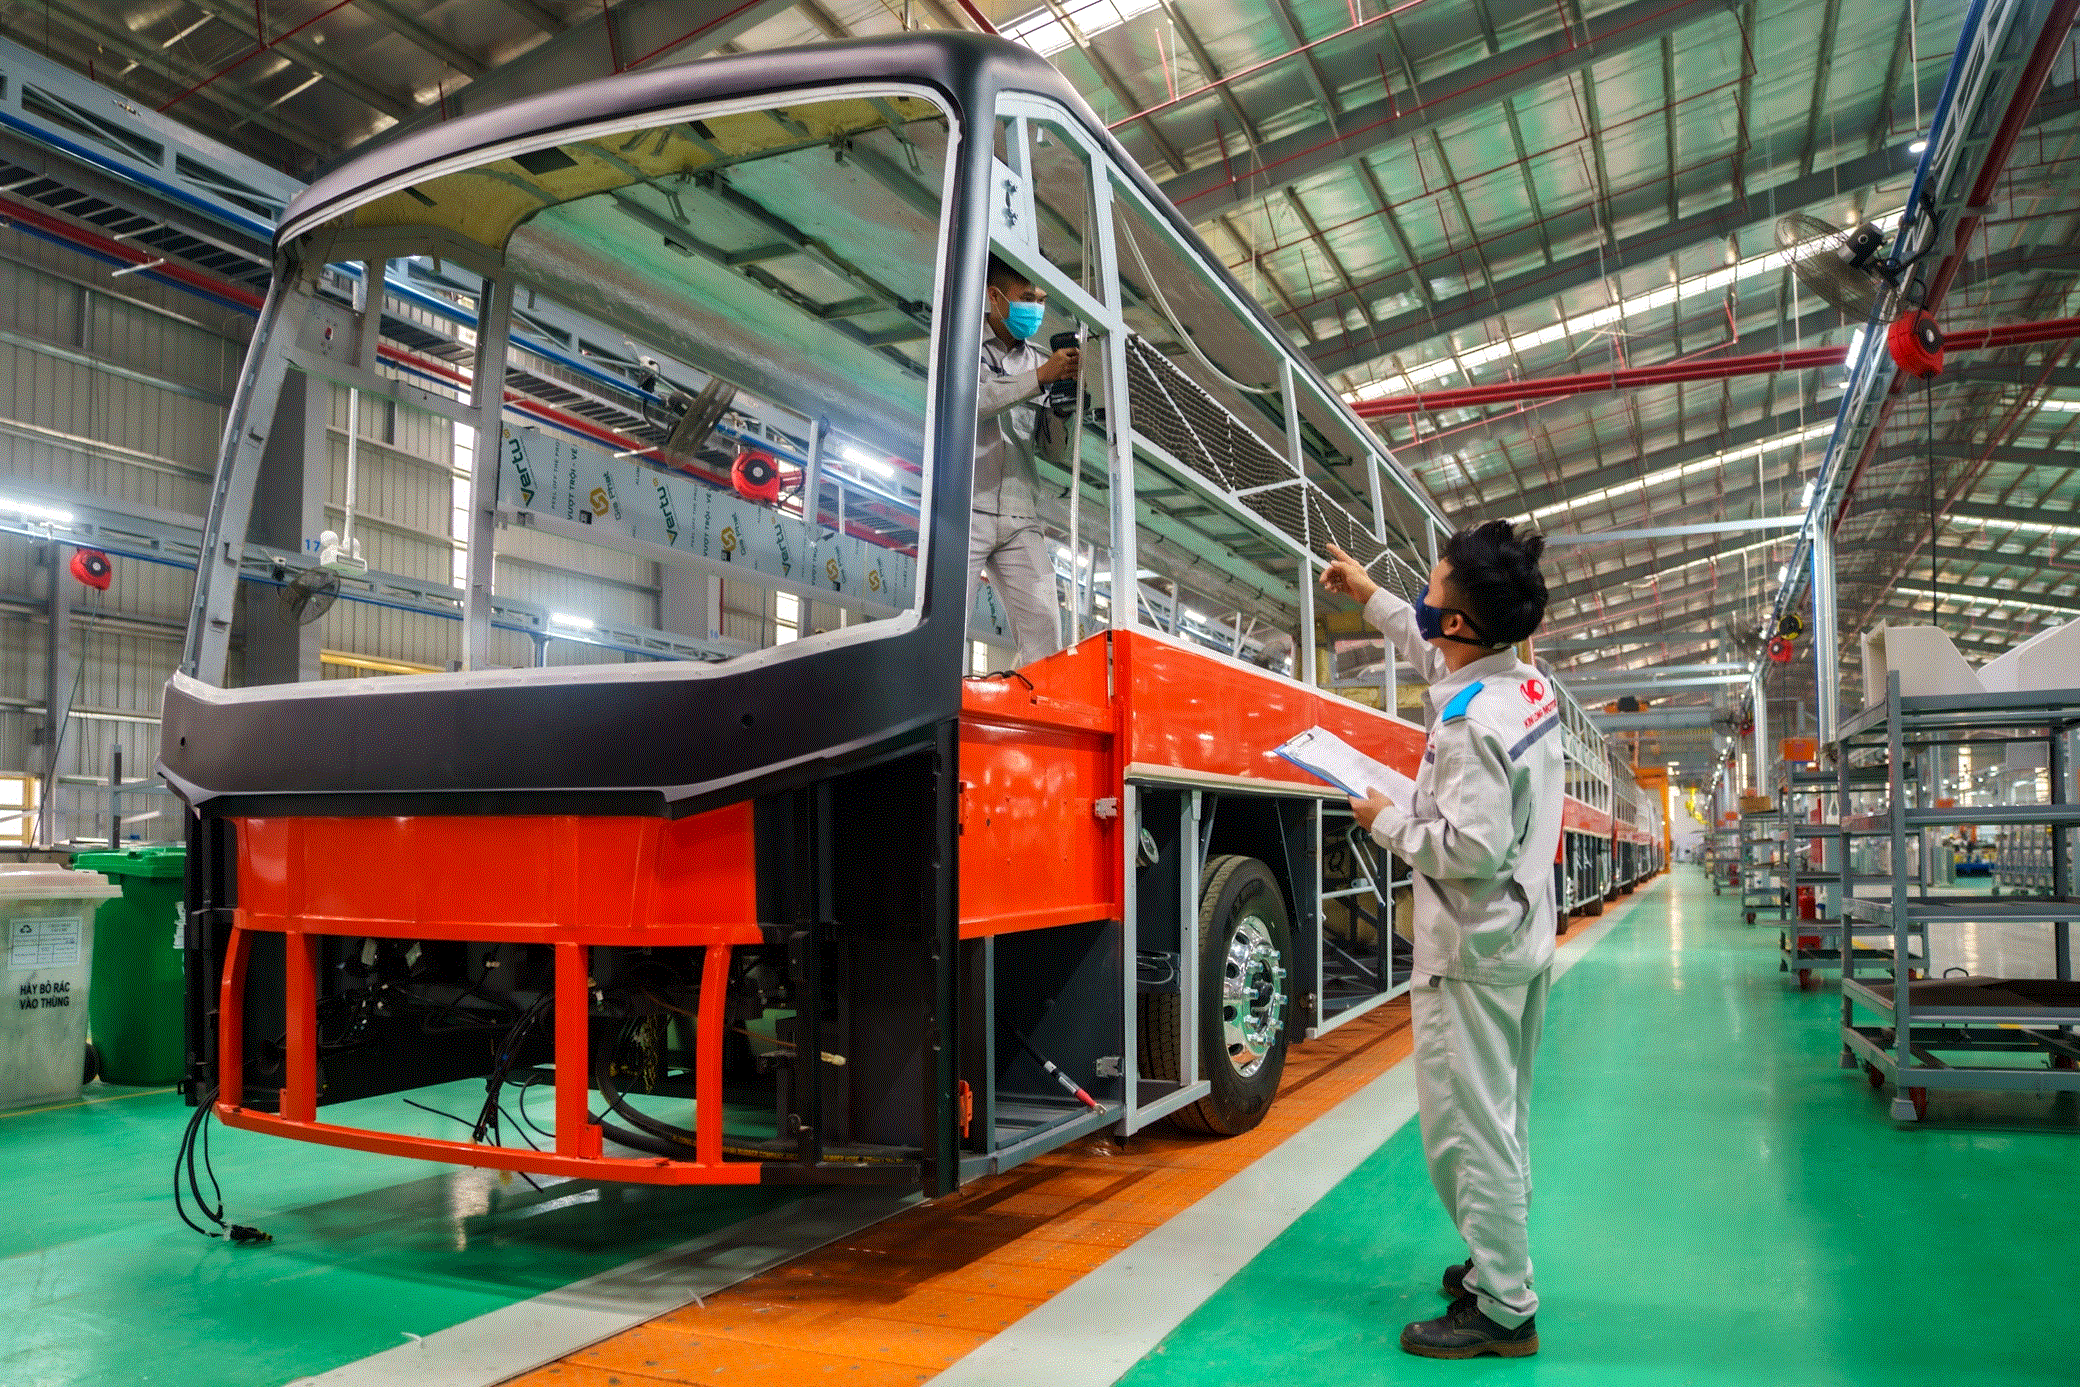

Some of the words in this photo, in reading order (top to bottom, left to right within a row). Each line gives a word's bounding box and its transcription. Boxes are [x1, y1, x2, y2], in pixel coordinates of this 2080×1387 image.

[508, 438, 535, 507] Vertu
[657, 486, 678, 547] Vertu
[305, 539, 320, 552] 17
[774, 524, 791, 578] Vertu
[41, 995, 70, 1009] THÙNG
[53, 979, 71, 993] RÁC
